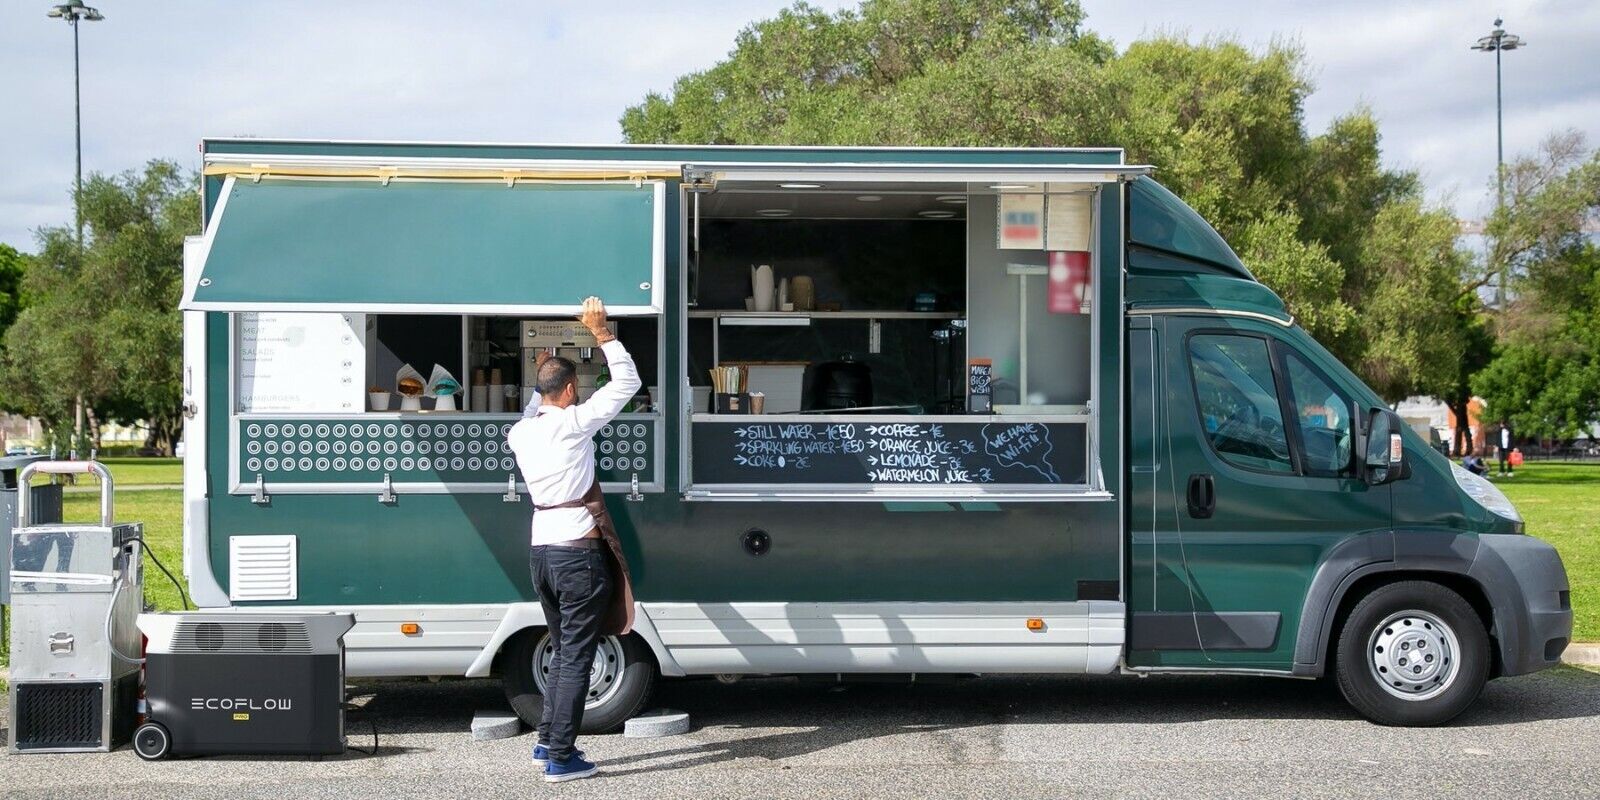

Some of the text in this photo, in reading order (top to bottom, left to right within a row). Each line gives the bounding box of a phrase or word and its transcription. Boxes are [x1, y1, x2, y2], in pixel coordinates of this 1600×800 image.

[778, 424, 816, 440] WATER
[878, 424, 920, 437] COFFEE
[802, 441, 836, 454] WATER
[880, 439, 921, 454] ORANGE
[747, 455, 777, 468] COKE
[881, 454, 940, 468] LEMONADE
[877, 468, 940, 482] WATERMELON
[191, 698, 292, 710] ECOFLOW
